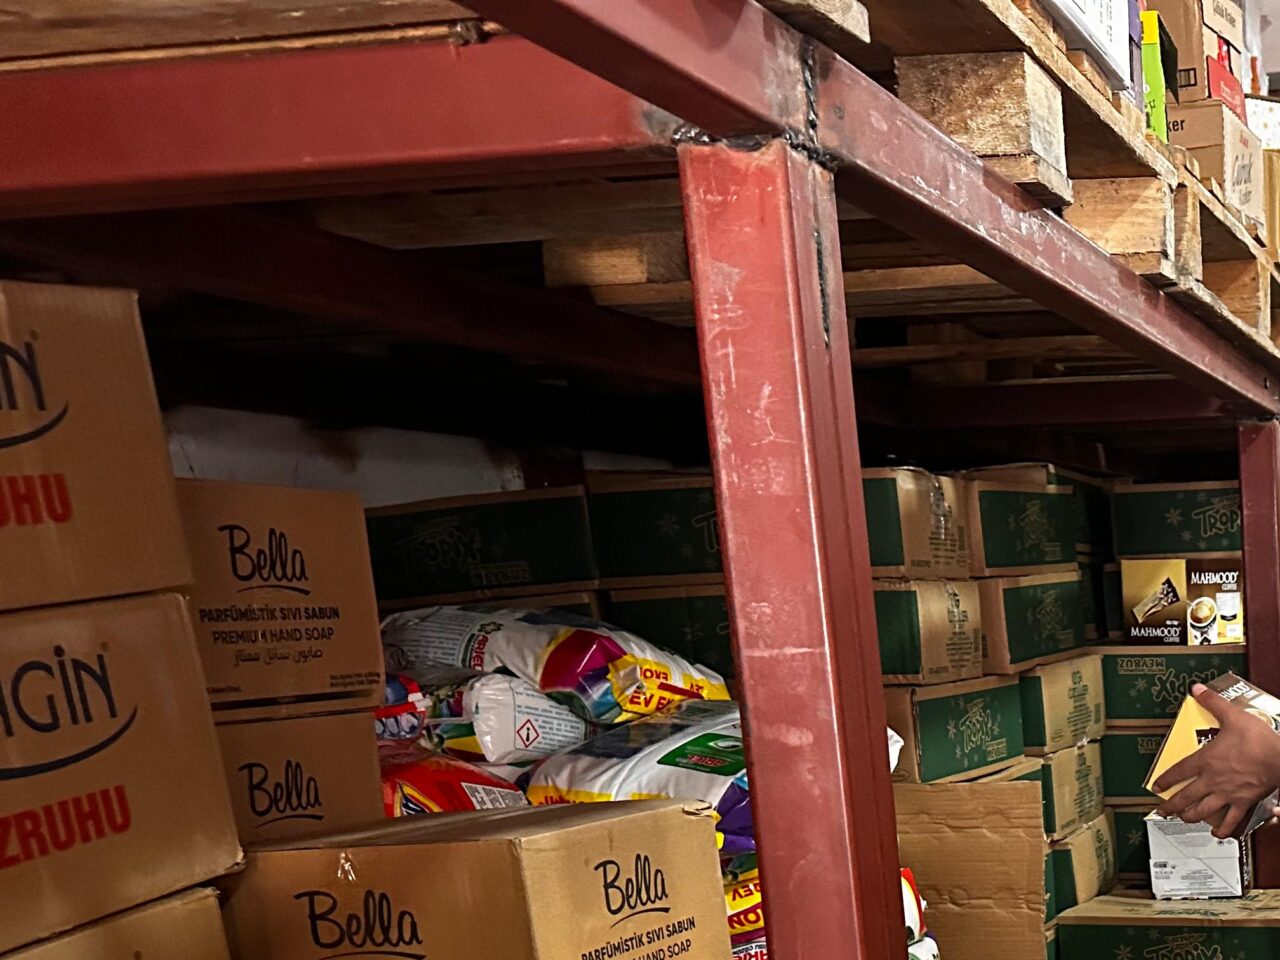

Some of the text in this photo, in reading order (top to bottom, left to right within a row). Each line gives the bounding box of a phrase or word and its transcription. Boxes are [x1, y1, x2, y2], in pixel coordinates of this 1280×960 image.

[1192, 501, 1241, 538] TROP
[217, 524, 308, 582] Bella
[1191, 571, 1236, 584] MAHMOOD
[304, 606, 340, 620] SABUN
[213, 626, 334, 645] PREMIUM HAND SOAP
[1131, 627, 1179, 637] MAHMOOD
[238, 760, 322, 817] Bella
[594, 854, 668, 915] Bella
[294, 889, 423, 948] Bella
[646, 926, 665, 946] SIVI
[666, 916, 695, 939] SABUN
[668, 938, 692, 960] SOAP
